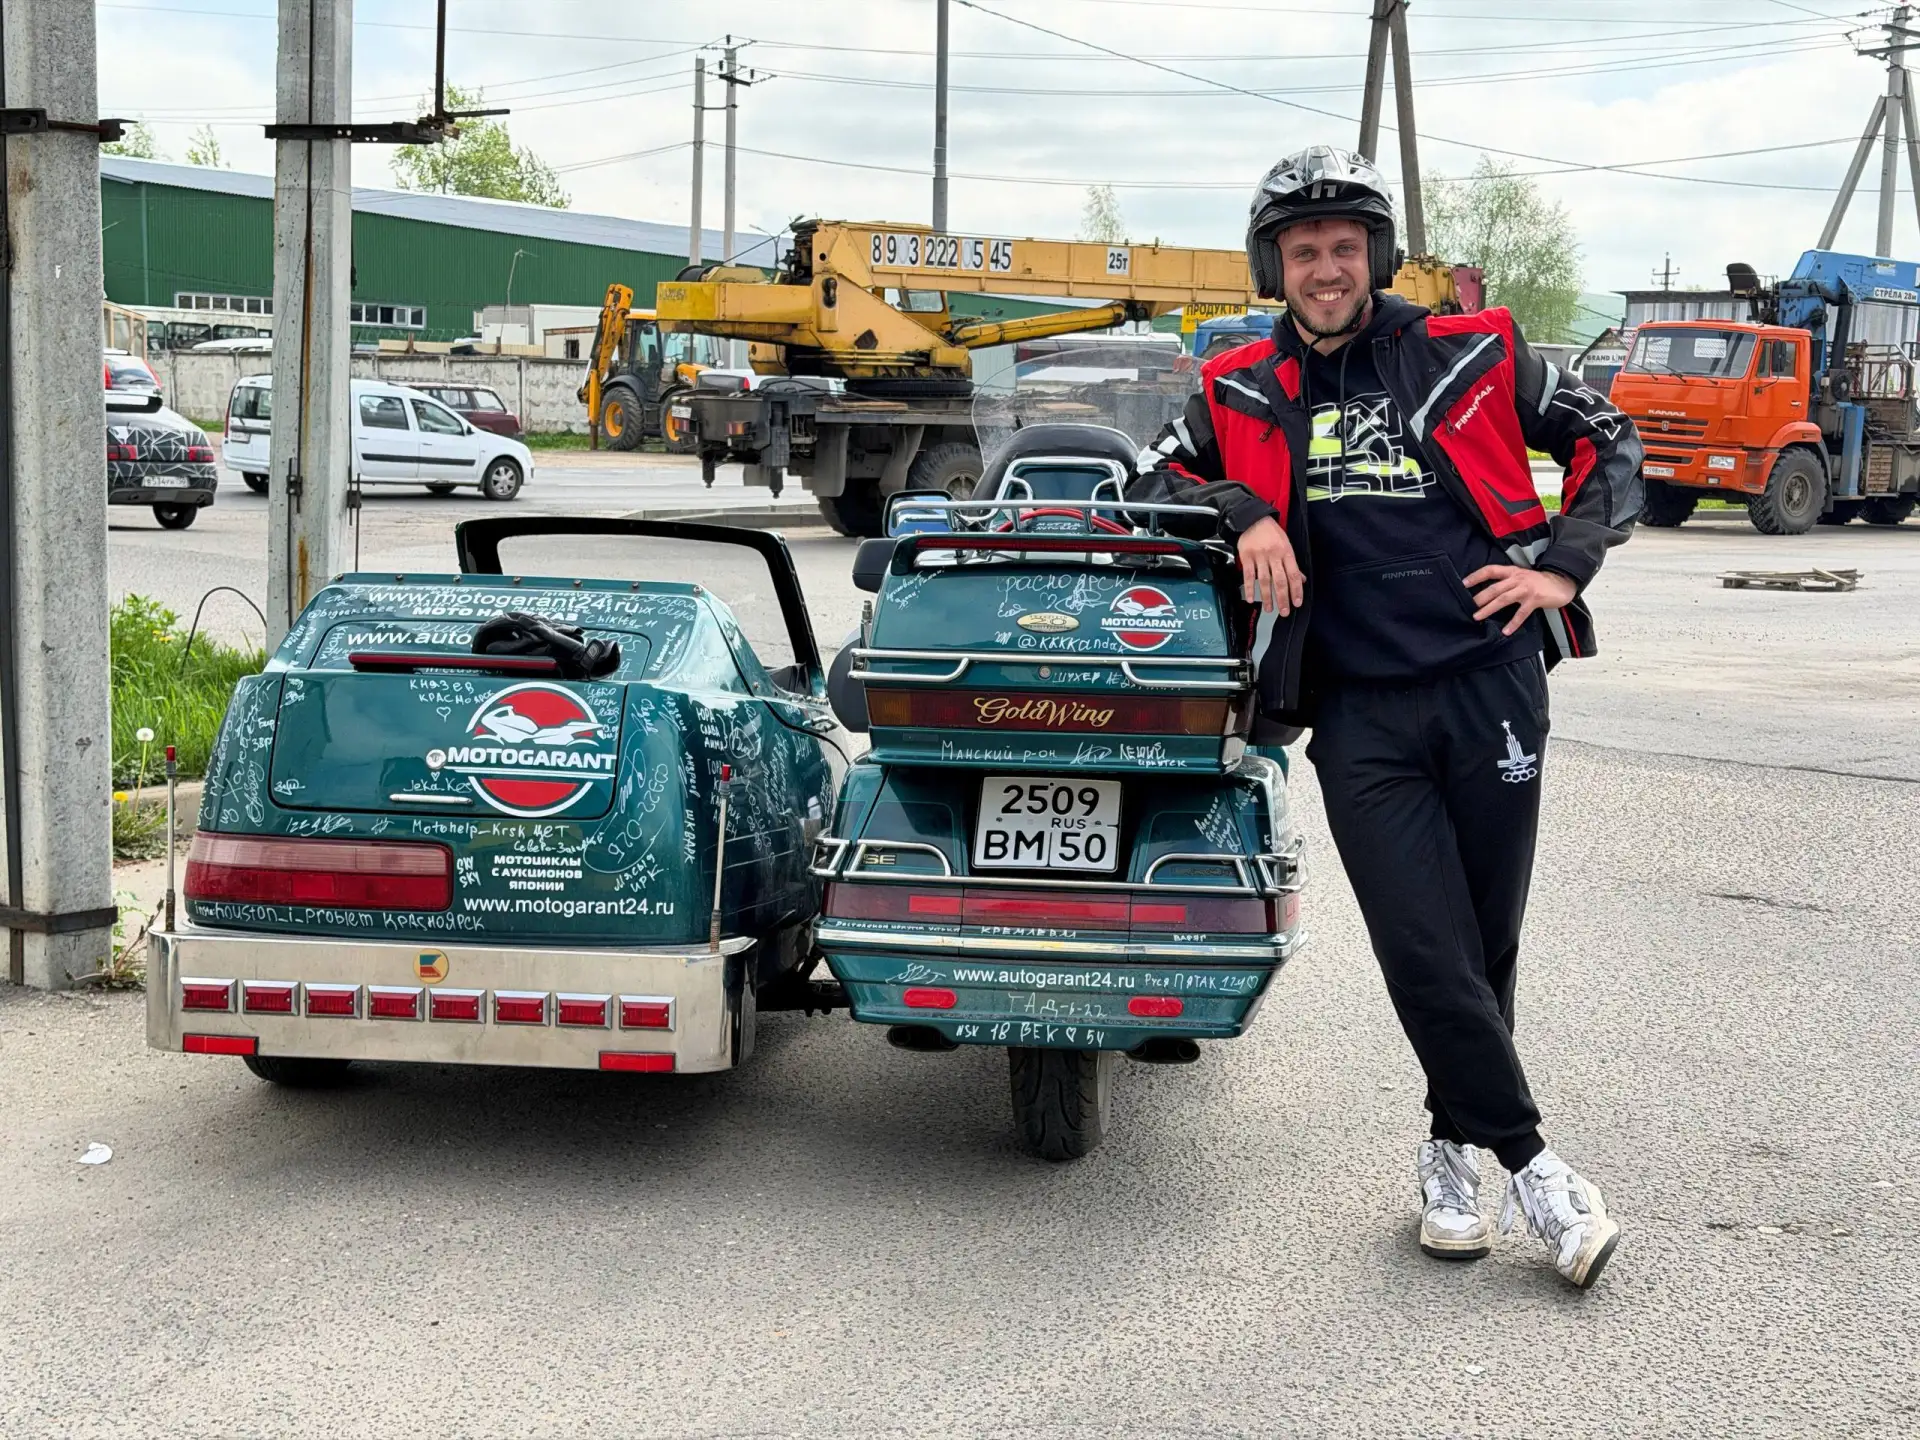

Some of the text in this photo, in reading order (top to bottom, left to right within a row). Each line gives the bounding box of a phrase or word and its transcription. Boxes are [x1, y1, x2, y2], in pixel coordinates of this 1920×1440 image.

[990, 240, 1012, 270] 45
[1454, 384, 1496, 431] FINNTRAIL
[1381, 567, 1434, 581] FINNTRAIL
[369, 592, 640, 614] www.motogarant24.ru
[1101, 617, 1184, 629] MOTOGARANT
[972, 697, 1115, 728] GoldWing
[447, 747, 617, 770] MOTOGARANT
[1000, 785, 1100, 817] 2509
[1051, 817, 1087, 830] RUS
[1058, 834, 1107, 864] 50
[494, 854, 582, 867] МОТОЦИКЛЫ
[492, 867, 583, 879] С АУКЦИОНОВ
[509, 880, 565, 892] ЯПОНИИ
[463, 897, 675, 918] www.motogarant24.ru
[953, 967, 1136, 989] www.autogarant24.ru
